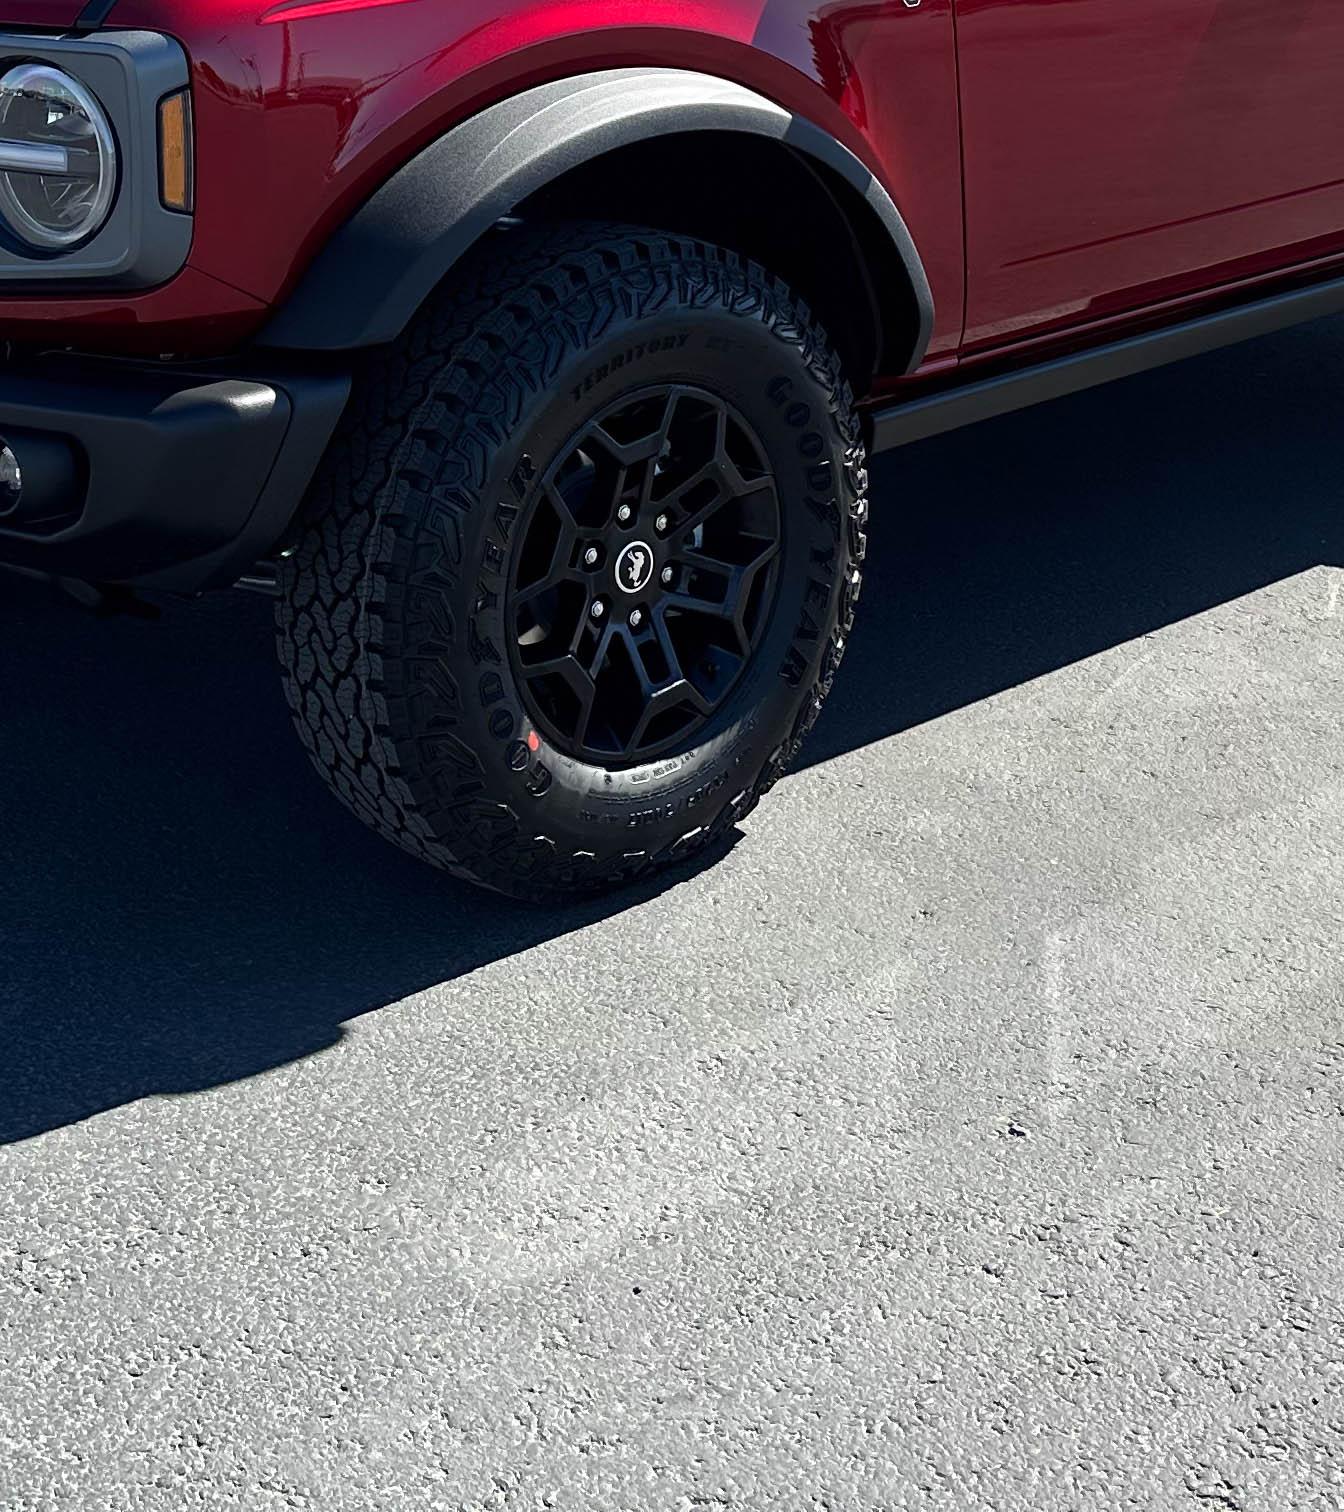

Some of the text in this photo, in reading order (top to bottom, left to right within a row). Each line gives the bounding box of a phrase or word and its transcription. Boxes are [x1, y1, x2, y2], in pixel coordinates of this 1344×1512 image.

[570, 332, 692, 404] TERRITORY
[469, 451, 552, 798] GOODYEAR
[765, 376, 844, 690] GOODYEAR
